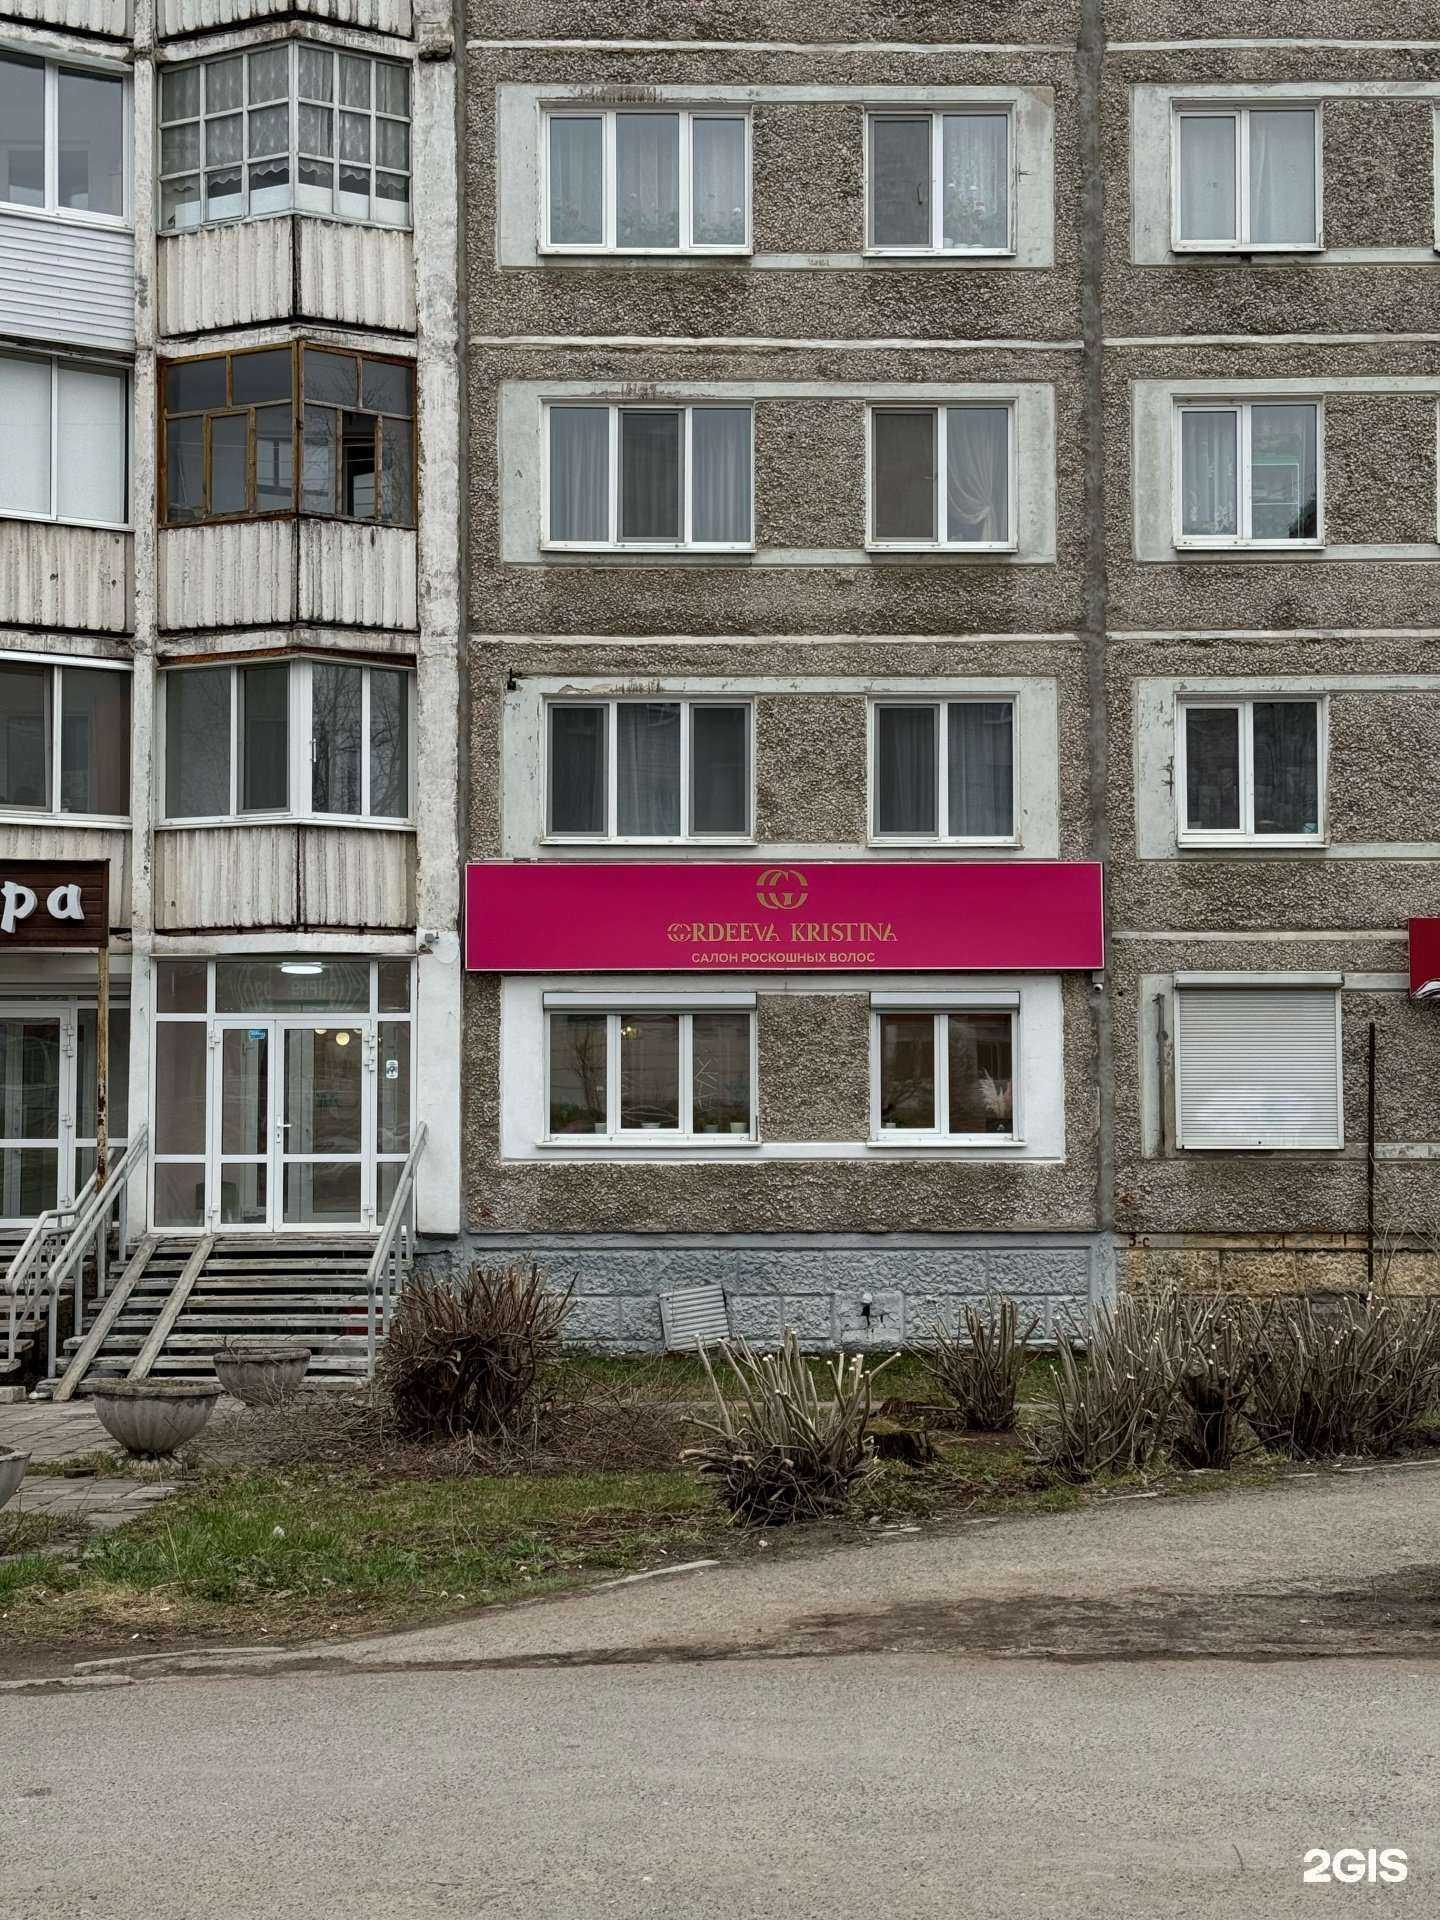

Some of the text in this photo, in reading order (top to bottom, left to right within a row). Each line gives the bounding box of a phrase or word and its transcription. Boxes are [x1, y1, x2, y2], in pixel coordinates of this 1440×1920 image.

[790, 922, 898, 942] KRISTINA
[691, 952, 876, 963] САЛОН РОСКОШНЫХ ВОЛОС
